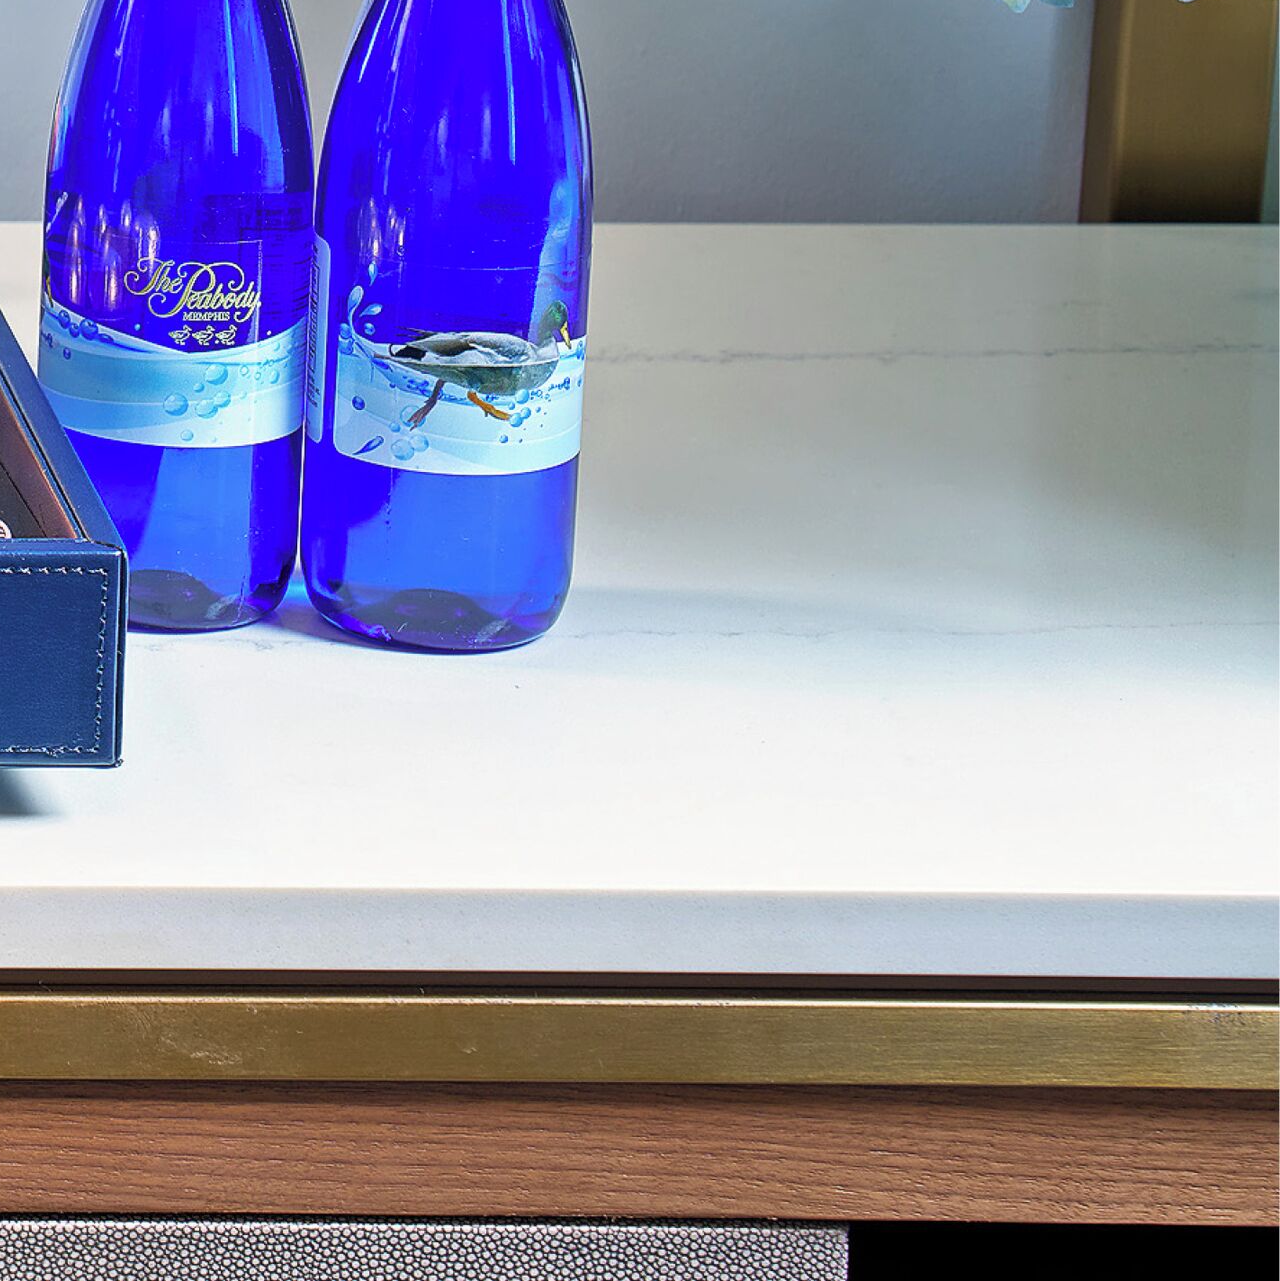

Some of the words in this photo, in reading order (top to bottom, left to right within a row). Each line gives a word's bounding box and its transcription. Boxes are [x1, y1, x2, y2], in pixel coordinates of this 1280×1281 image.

[123, 256, 184, 296] The
[147, 260, 260, 323] Peabody
[182, 311, 231, 322] MEMPHIS
